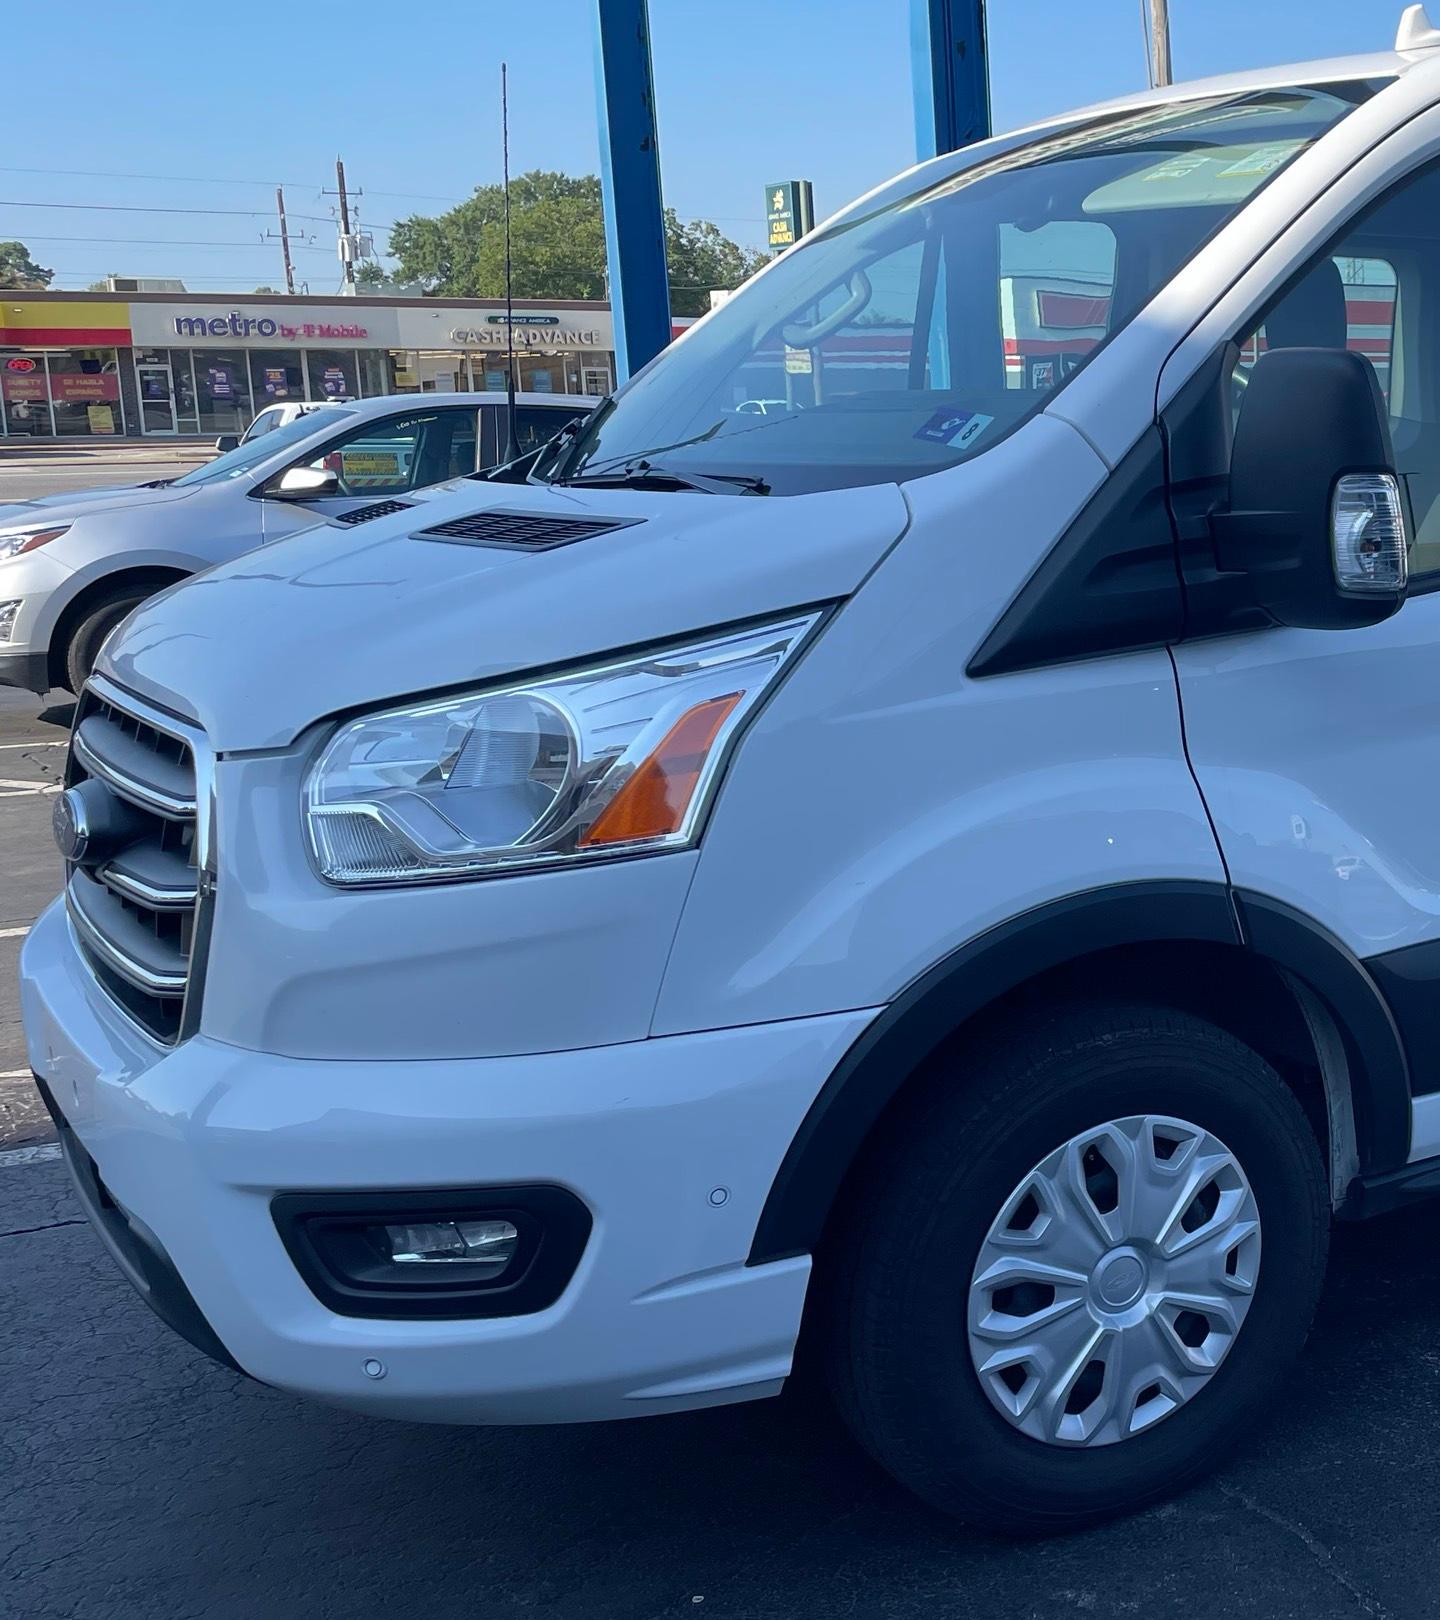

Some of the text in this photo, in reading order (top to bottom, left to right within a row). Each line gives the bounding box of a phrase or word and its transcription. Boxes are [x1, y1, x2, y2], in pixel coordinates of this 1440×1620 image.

[174, 311, 278, 337] metro
[280, 324, 298, 341] by
[452, 327, 601, 345] CASH ADVANCE
